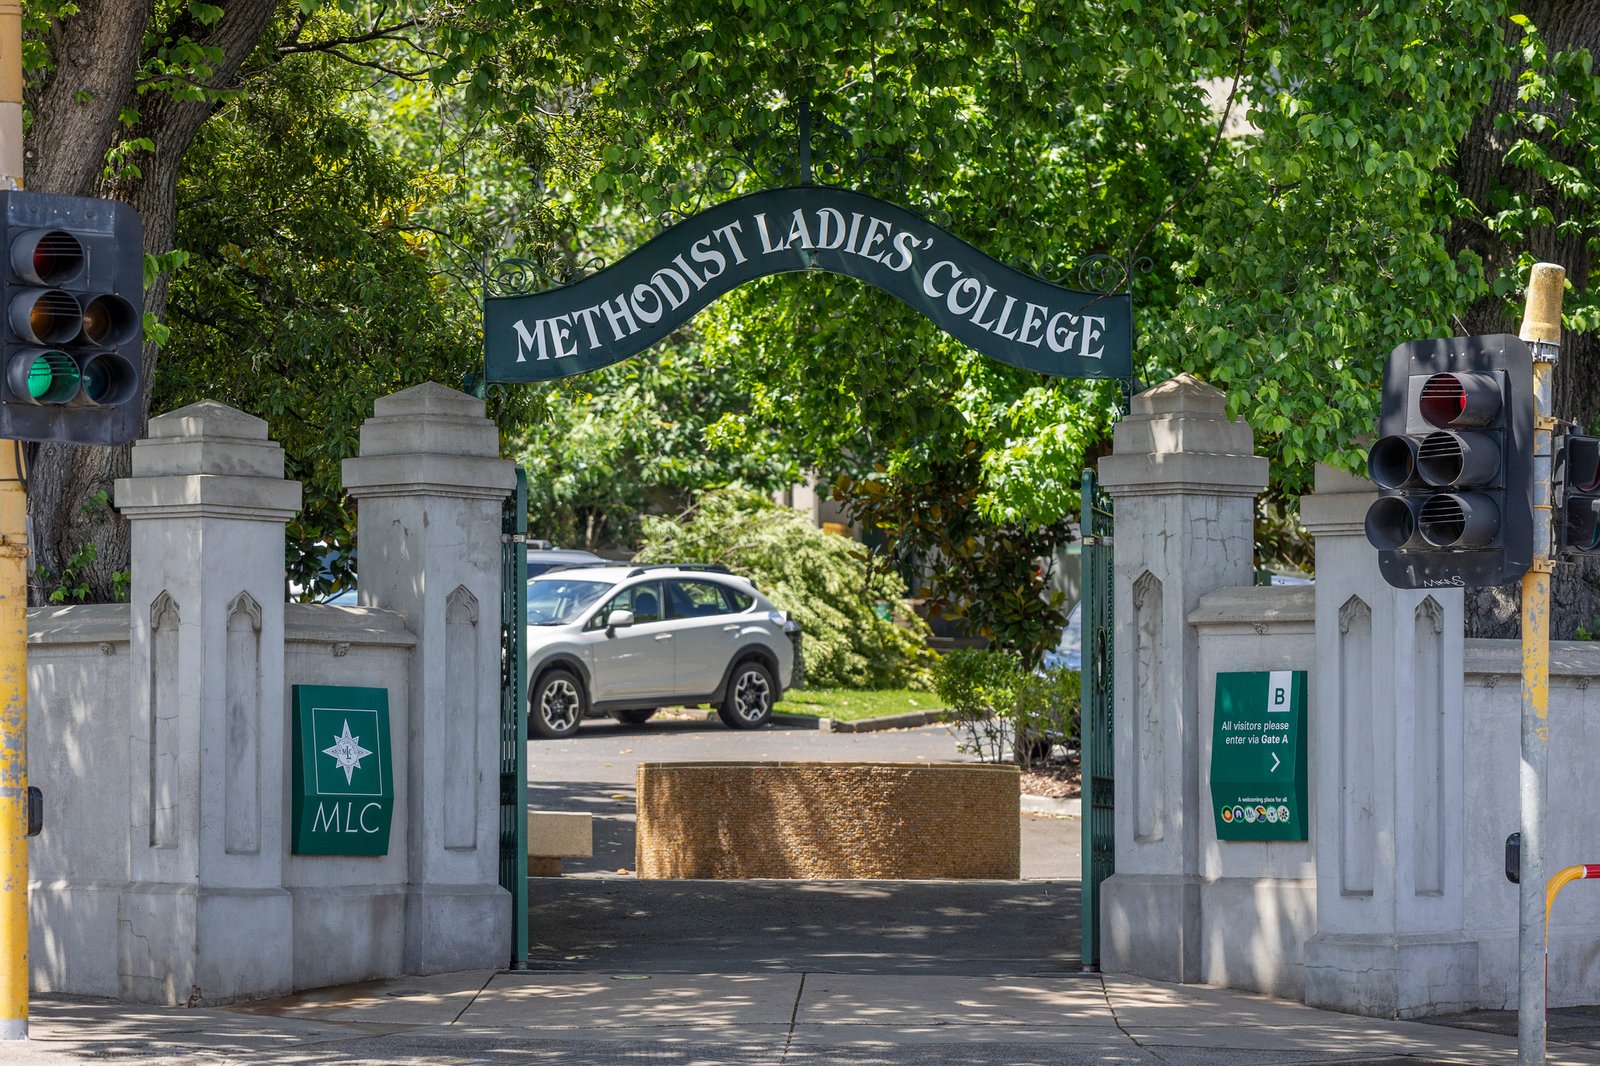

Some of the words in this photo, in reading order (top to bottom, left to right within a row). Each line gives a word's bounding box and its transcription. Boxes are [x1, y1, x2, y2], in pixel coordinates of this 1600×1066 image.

[512, 219, 749, 363] METHODIST
[922, 260, 1106, 360] COLLEGE
[1275, 688, 1285, 705] B
[1222, 721, 1232, 731] All
[1233, 721, 1262, 731] visitors
[1263, 721, 1289, 732] please
[1225, 736, 1246, 745] enter
[1248, 735, 1260, 744] via
[1261, 734, 1280, 744] Gate
[1281, 735, 1288, 744] A
[312, 801, 382, 833] MLC
